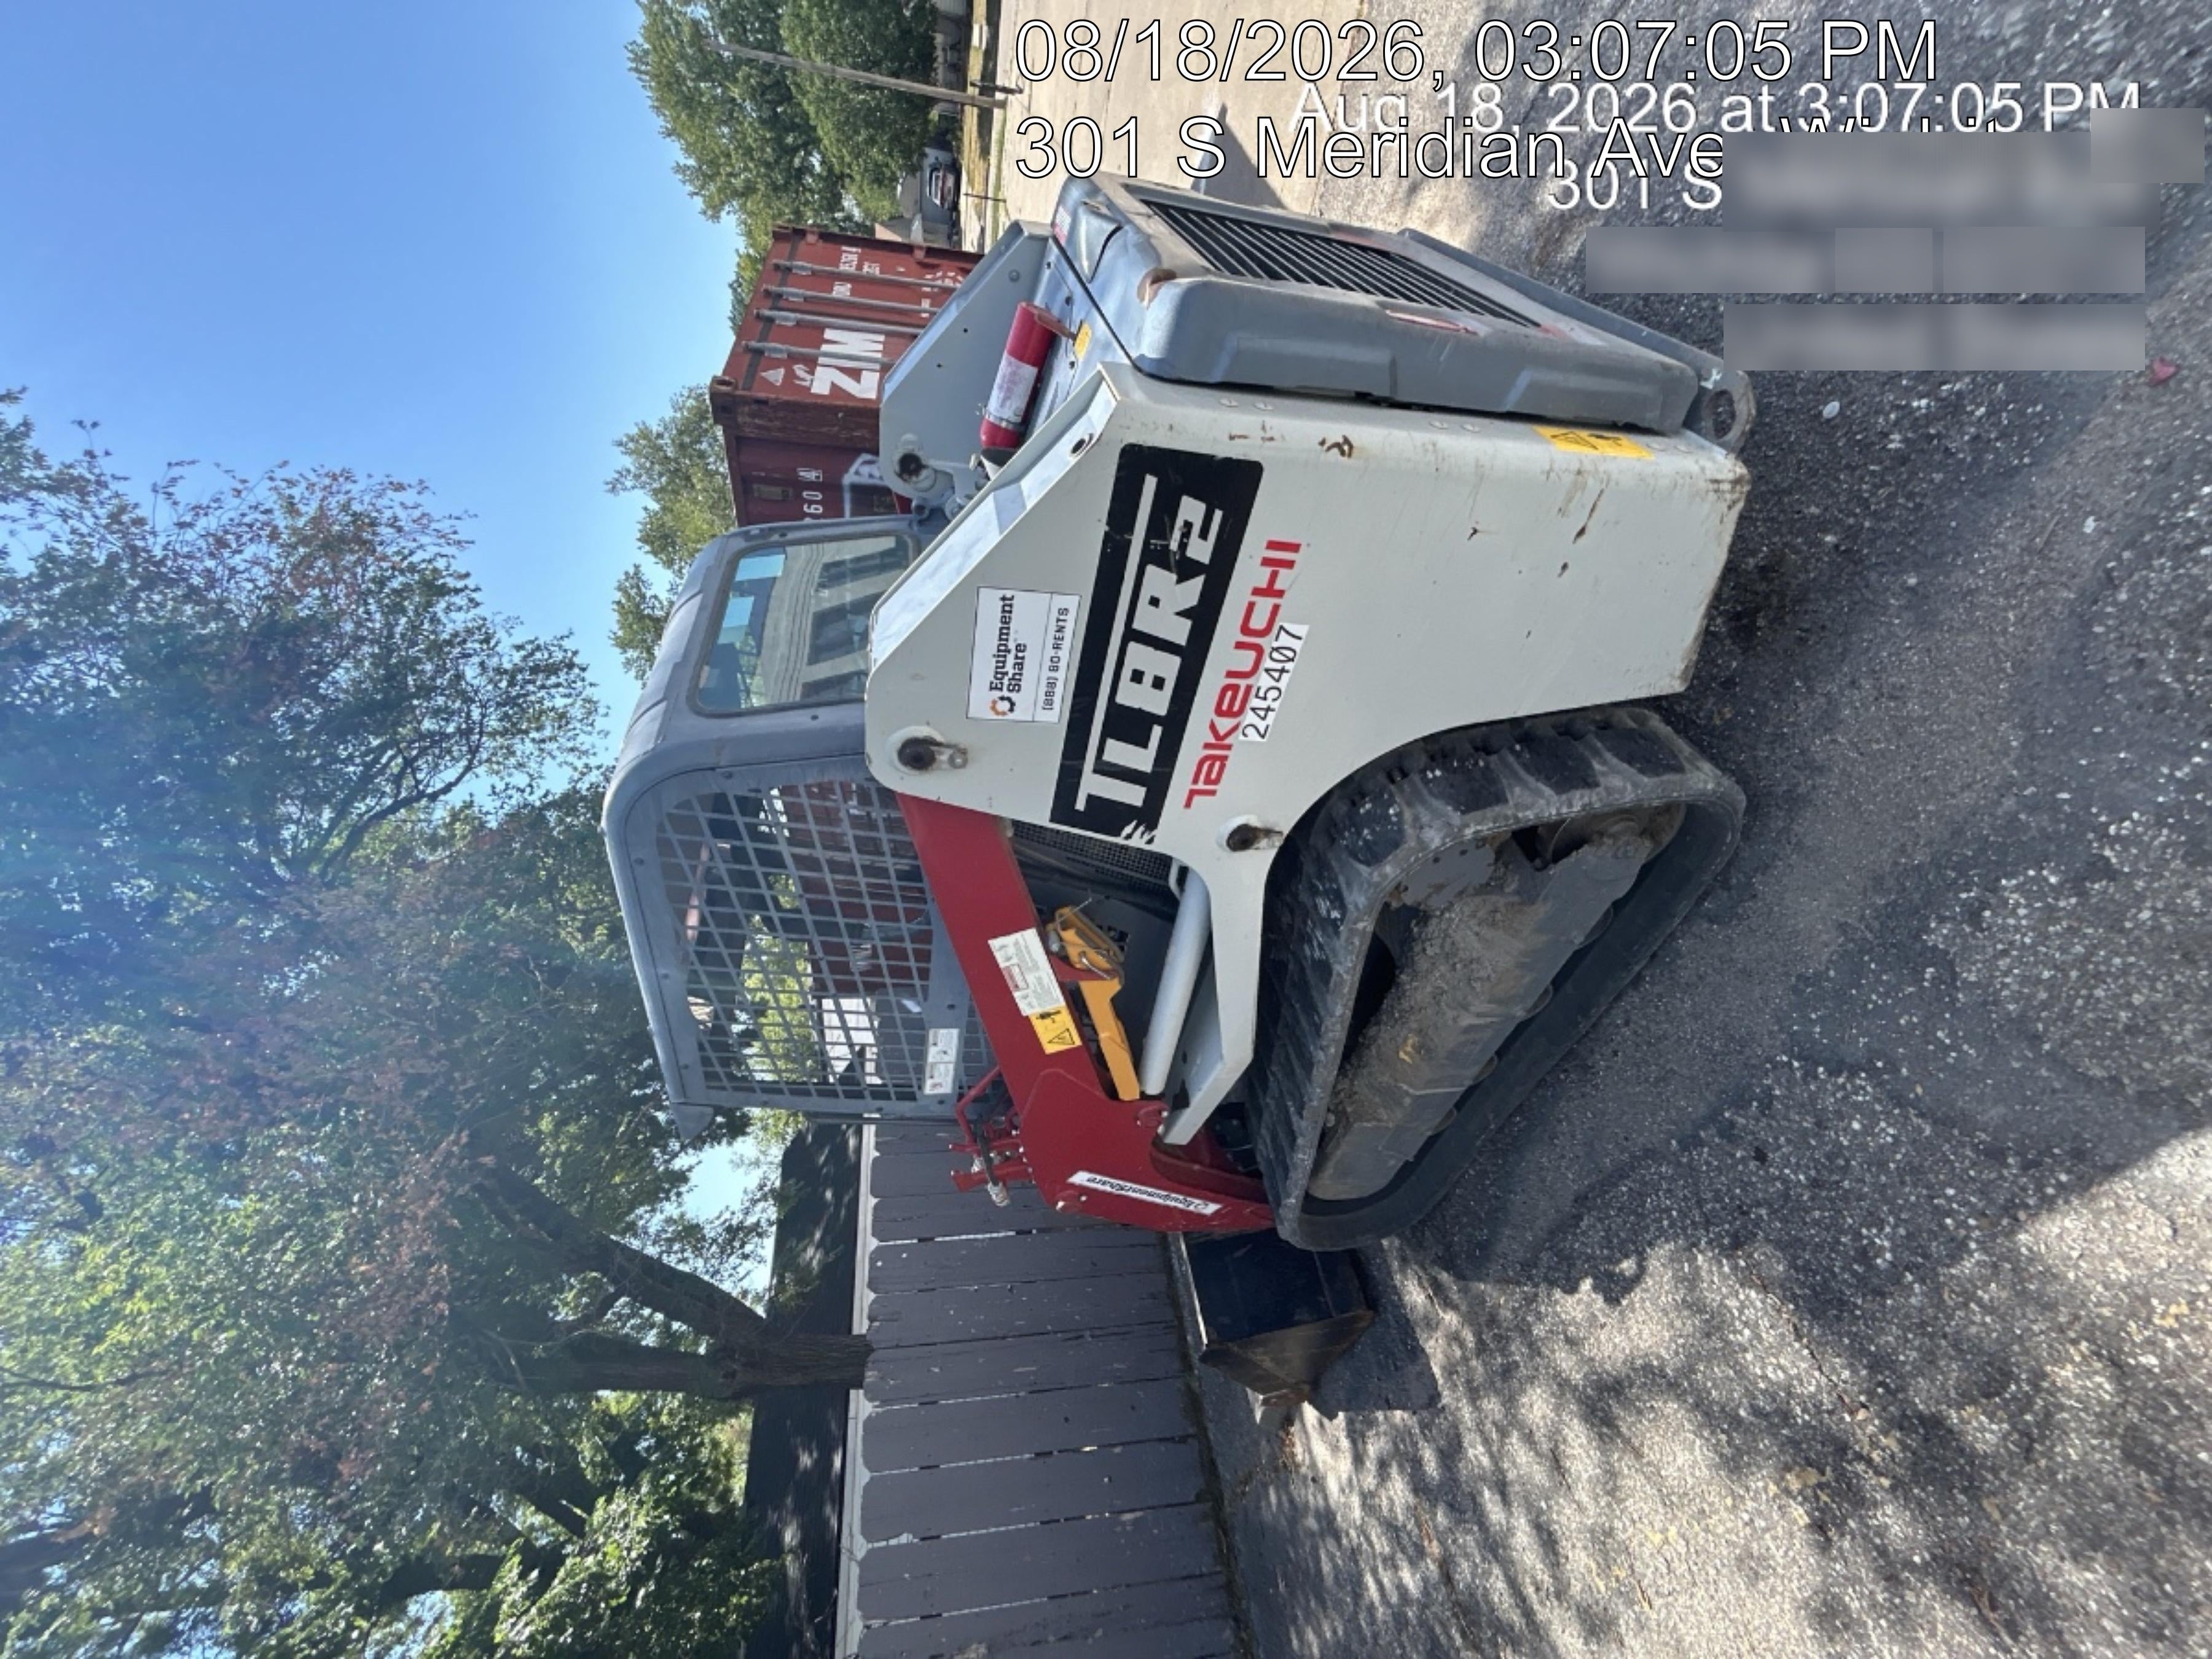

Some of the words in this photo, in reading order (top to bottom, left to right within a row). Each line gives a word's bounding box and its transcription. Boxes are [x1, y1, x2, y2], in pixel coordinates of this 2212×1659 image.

[810, 327, 885, 399] ZIM
[989, 594, 1015, 692] Equipment
[1006, 643, 1027, 693] Share
[1242, 624, 1303, 740] 245407
